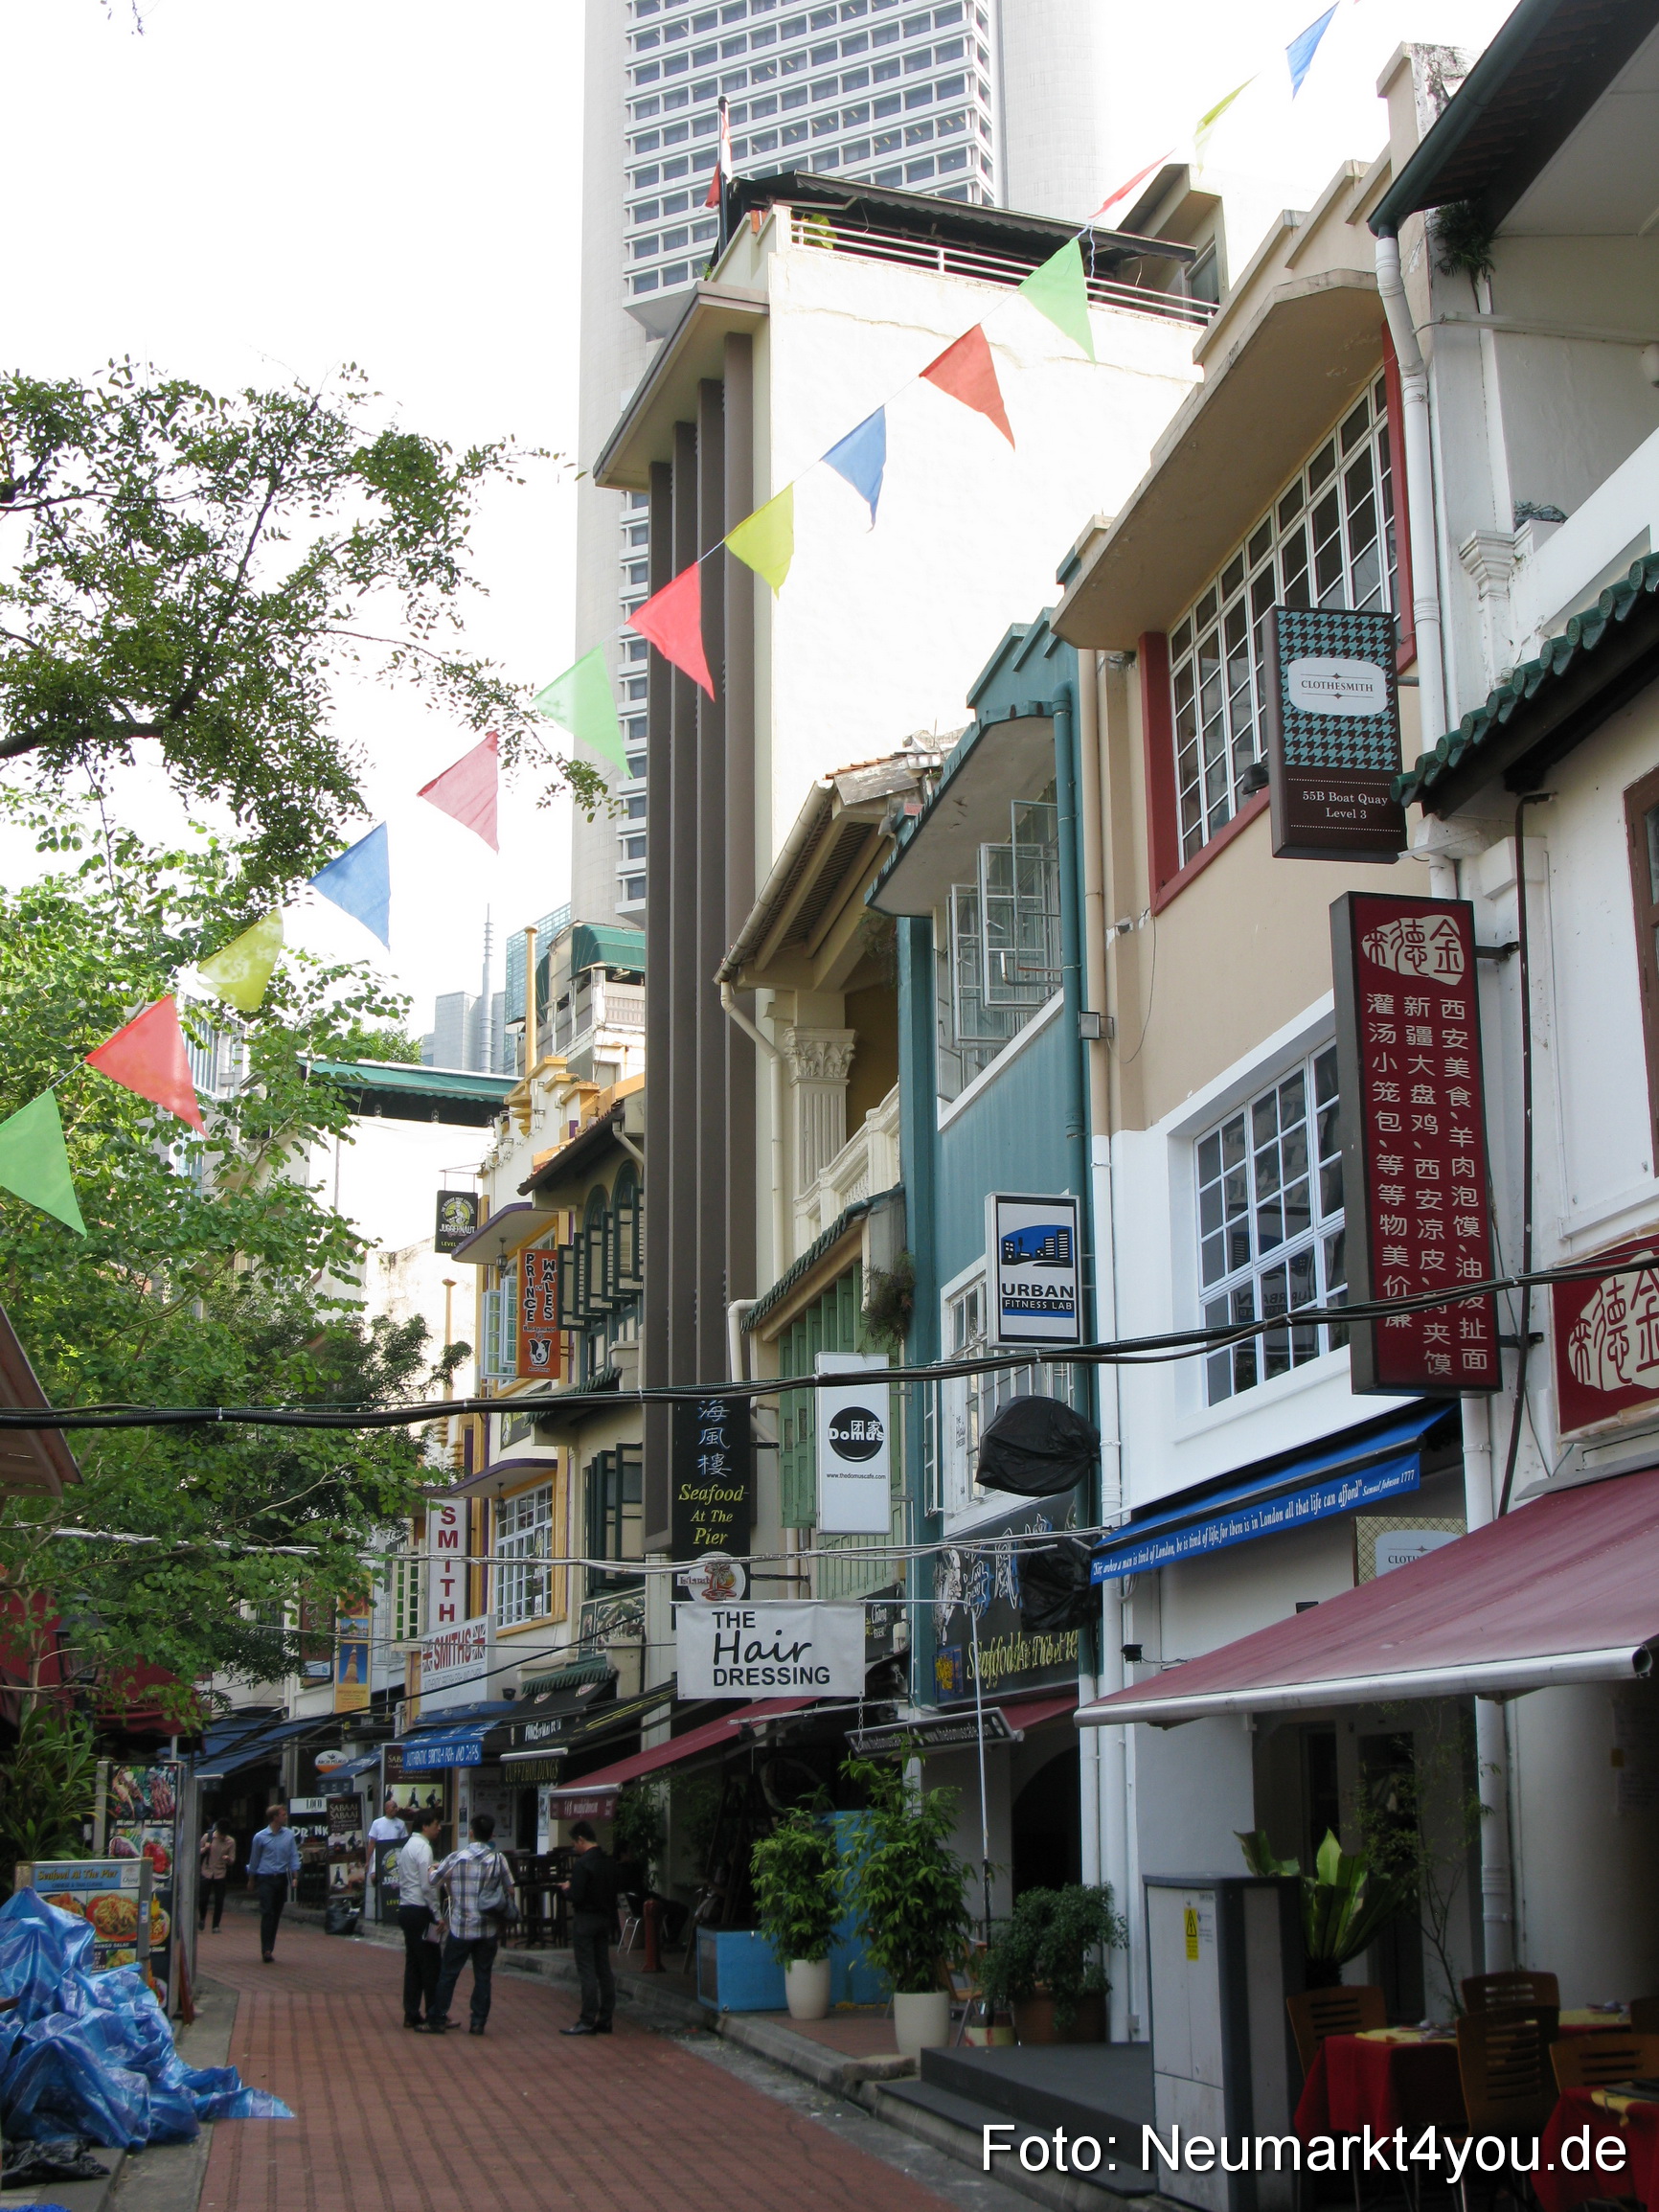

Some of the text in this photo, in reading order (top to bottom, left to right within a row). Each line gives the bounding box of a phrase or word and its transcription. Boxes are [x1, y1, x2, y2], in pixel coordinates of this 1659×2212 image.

[1301, 679, 1374, 693] CLOTHESMITH
[1302, 790, 1388, 807] 55B Boat Quay
[1326, 807, 1367, 819] Level 3
[524, 1253, 536, 1322] PRINCE
[542, 1259, 557, 1320] WALES
[1001, 1283, 1074, 1299] URBAN
[1005, 1299, 1073, 1311] FITNESS LAB
[828, 1426, 885, 1442] Domus
[1400, 1469, 1415, 1484] 1777
[678, 1483, 744, 1505] Seafood
[691, 1510, 734, 1523] At The
[693, 1528, 728, 1546] Pier
[1123, 1557, 1132, 1570] man
[1133, 1553, 1137, 1566] is
[1138, 1548, 1149, 1564] tired
[1149, 1544, 1155, 1564] of
[1155, 1541, 1175, 1560] London,
[1176, 1538, 1183, 1552] he
[1183, 1537, 1189, 1551] is
[1189, 1530, 1201, 1548] tired
[1202, 1527, 1208, 1548] of
[1218, 1521, 1228, 1543] for
[1229, 1519, 1243, 1539] there
[1244, 1517, 1250, 1533] is
[1251, 1515, 1259, 1530] in
[1260, 1507, 1284, 1528] London
[1284, 1500, 1295, 1518] all
[1295, 1497, 1309, 1516] that
[1310, 1493, 1322, 1515] life
[1324, 1494, 1336, 1508] can
[438, 1507, 459, 1622] SMITH
[712, 1611, 756, 1629] THE
[434, 1628, 471, 1671] SMITHS
[713, 1629, 812, 1666] Hair
[713, 1666, 830, 1687] DRESSING
[330, 1803, 358, 1813] SABAAI
[330, 1811, 358, 1820] SABAAI
[37, 1868, 118, 1881] Seafood At The Pier
